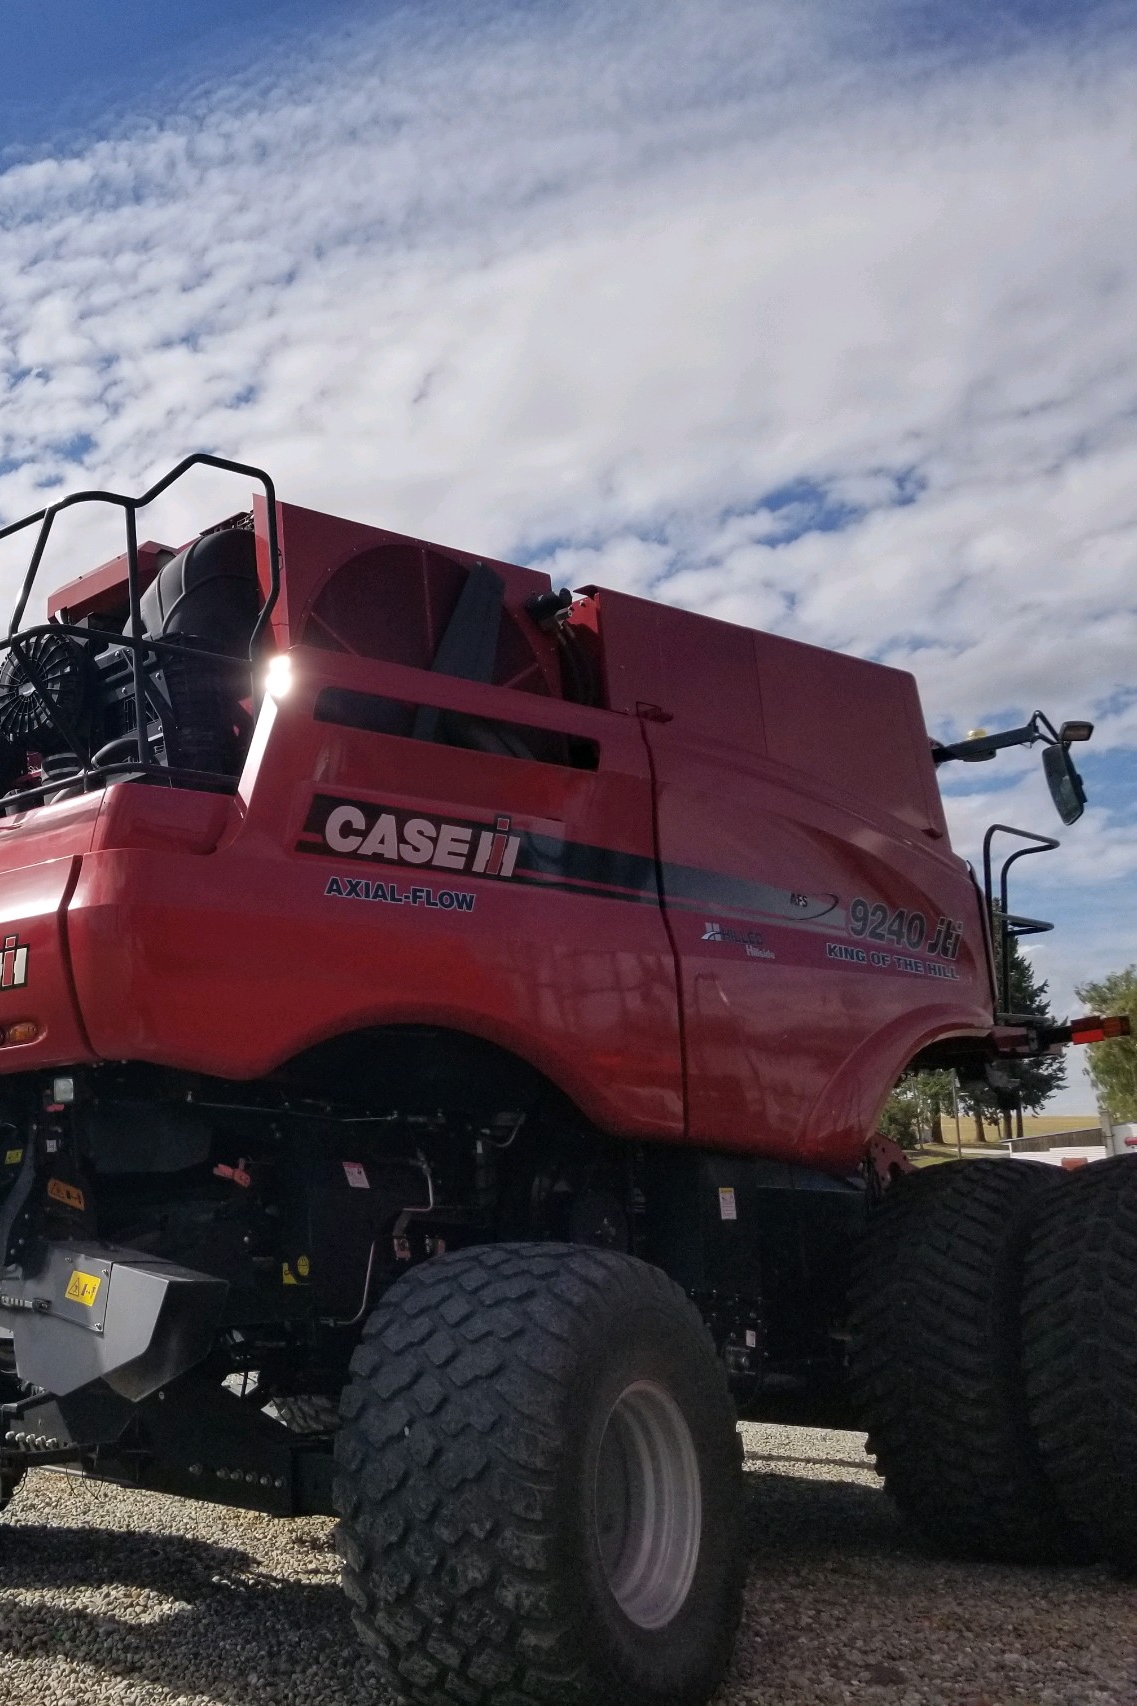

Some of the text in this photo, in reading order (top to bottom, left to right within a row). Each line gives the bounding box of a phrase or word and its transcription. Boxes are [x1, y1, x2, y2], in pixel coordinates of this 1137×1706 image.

[325, 805, 473, 870] CASE
[324, 876, 476, 912] AXIAL-FLOW
[849, 898, 926, 951] 9240
[826, 942, 960, 981] KING OF THE HILL
